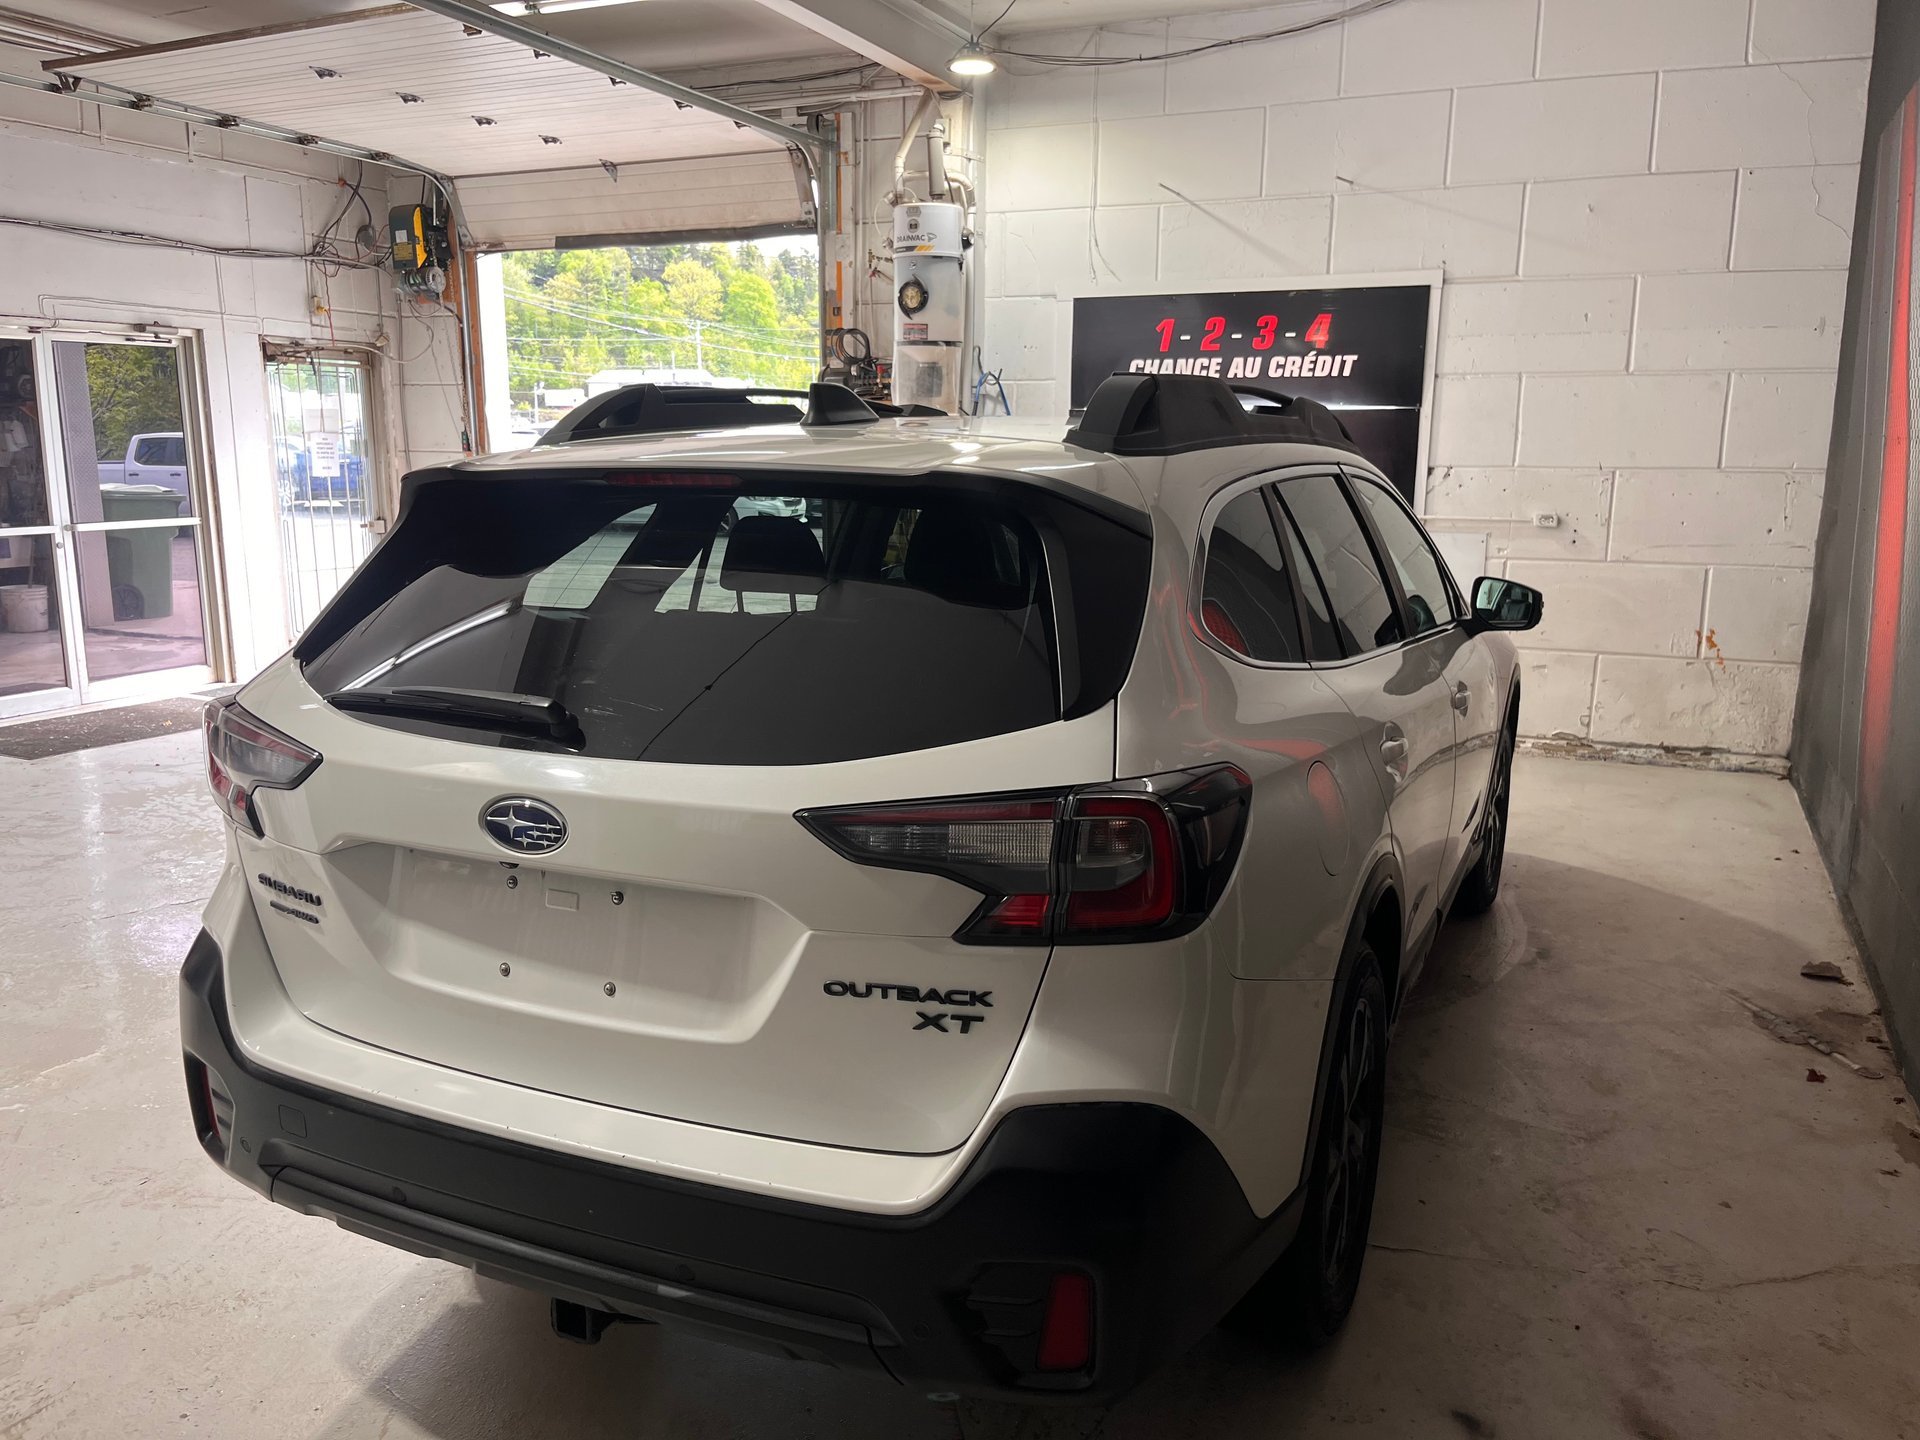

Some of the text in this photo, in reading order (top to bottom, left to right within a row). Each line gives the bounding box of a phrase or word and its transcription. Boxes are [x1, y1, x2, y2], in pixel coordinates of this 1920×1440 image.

[1155, 318, 1175, 352] 1
[1200, 316, 1226, 350] 2
[1252, 315, 1279, 350] 3
[1305, 313, 1332, 349] 4
[1129, 351, 1358, 379] CHANCE AU CRÉDIT
[258, 873, 322, 907] SUBARU
[823, 980, 994, 1007] OUTBACK
[912, 1011, 985, 1034] XT
